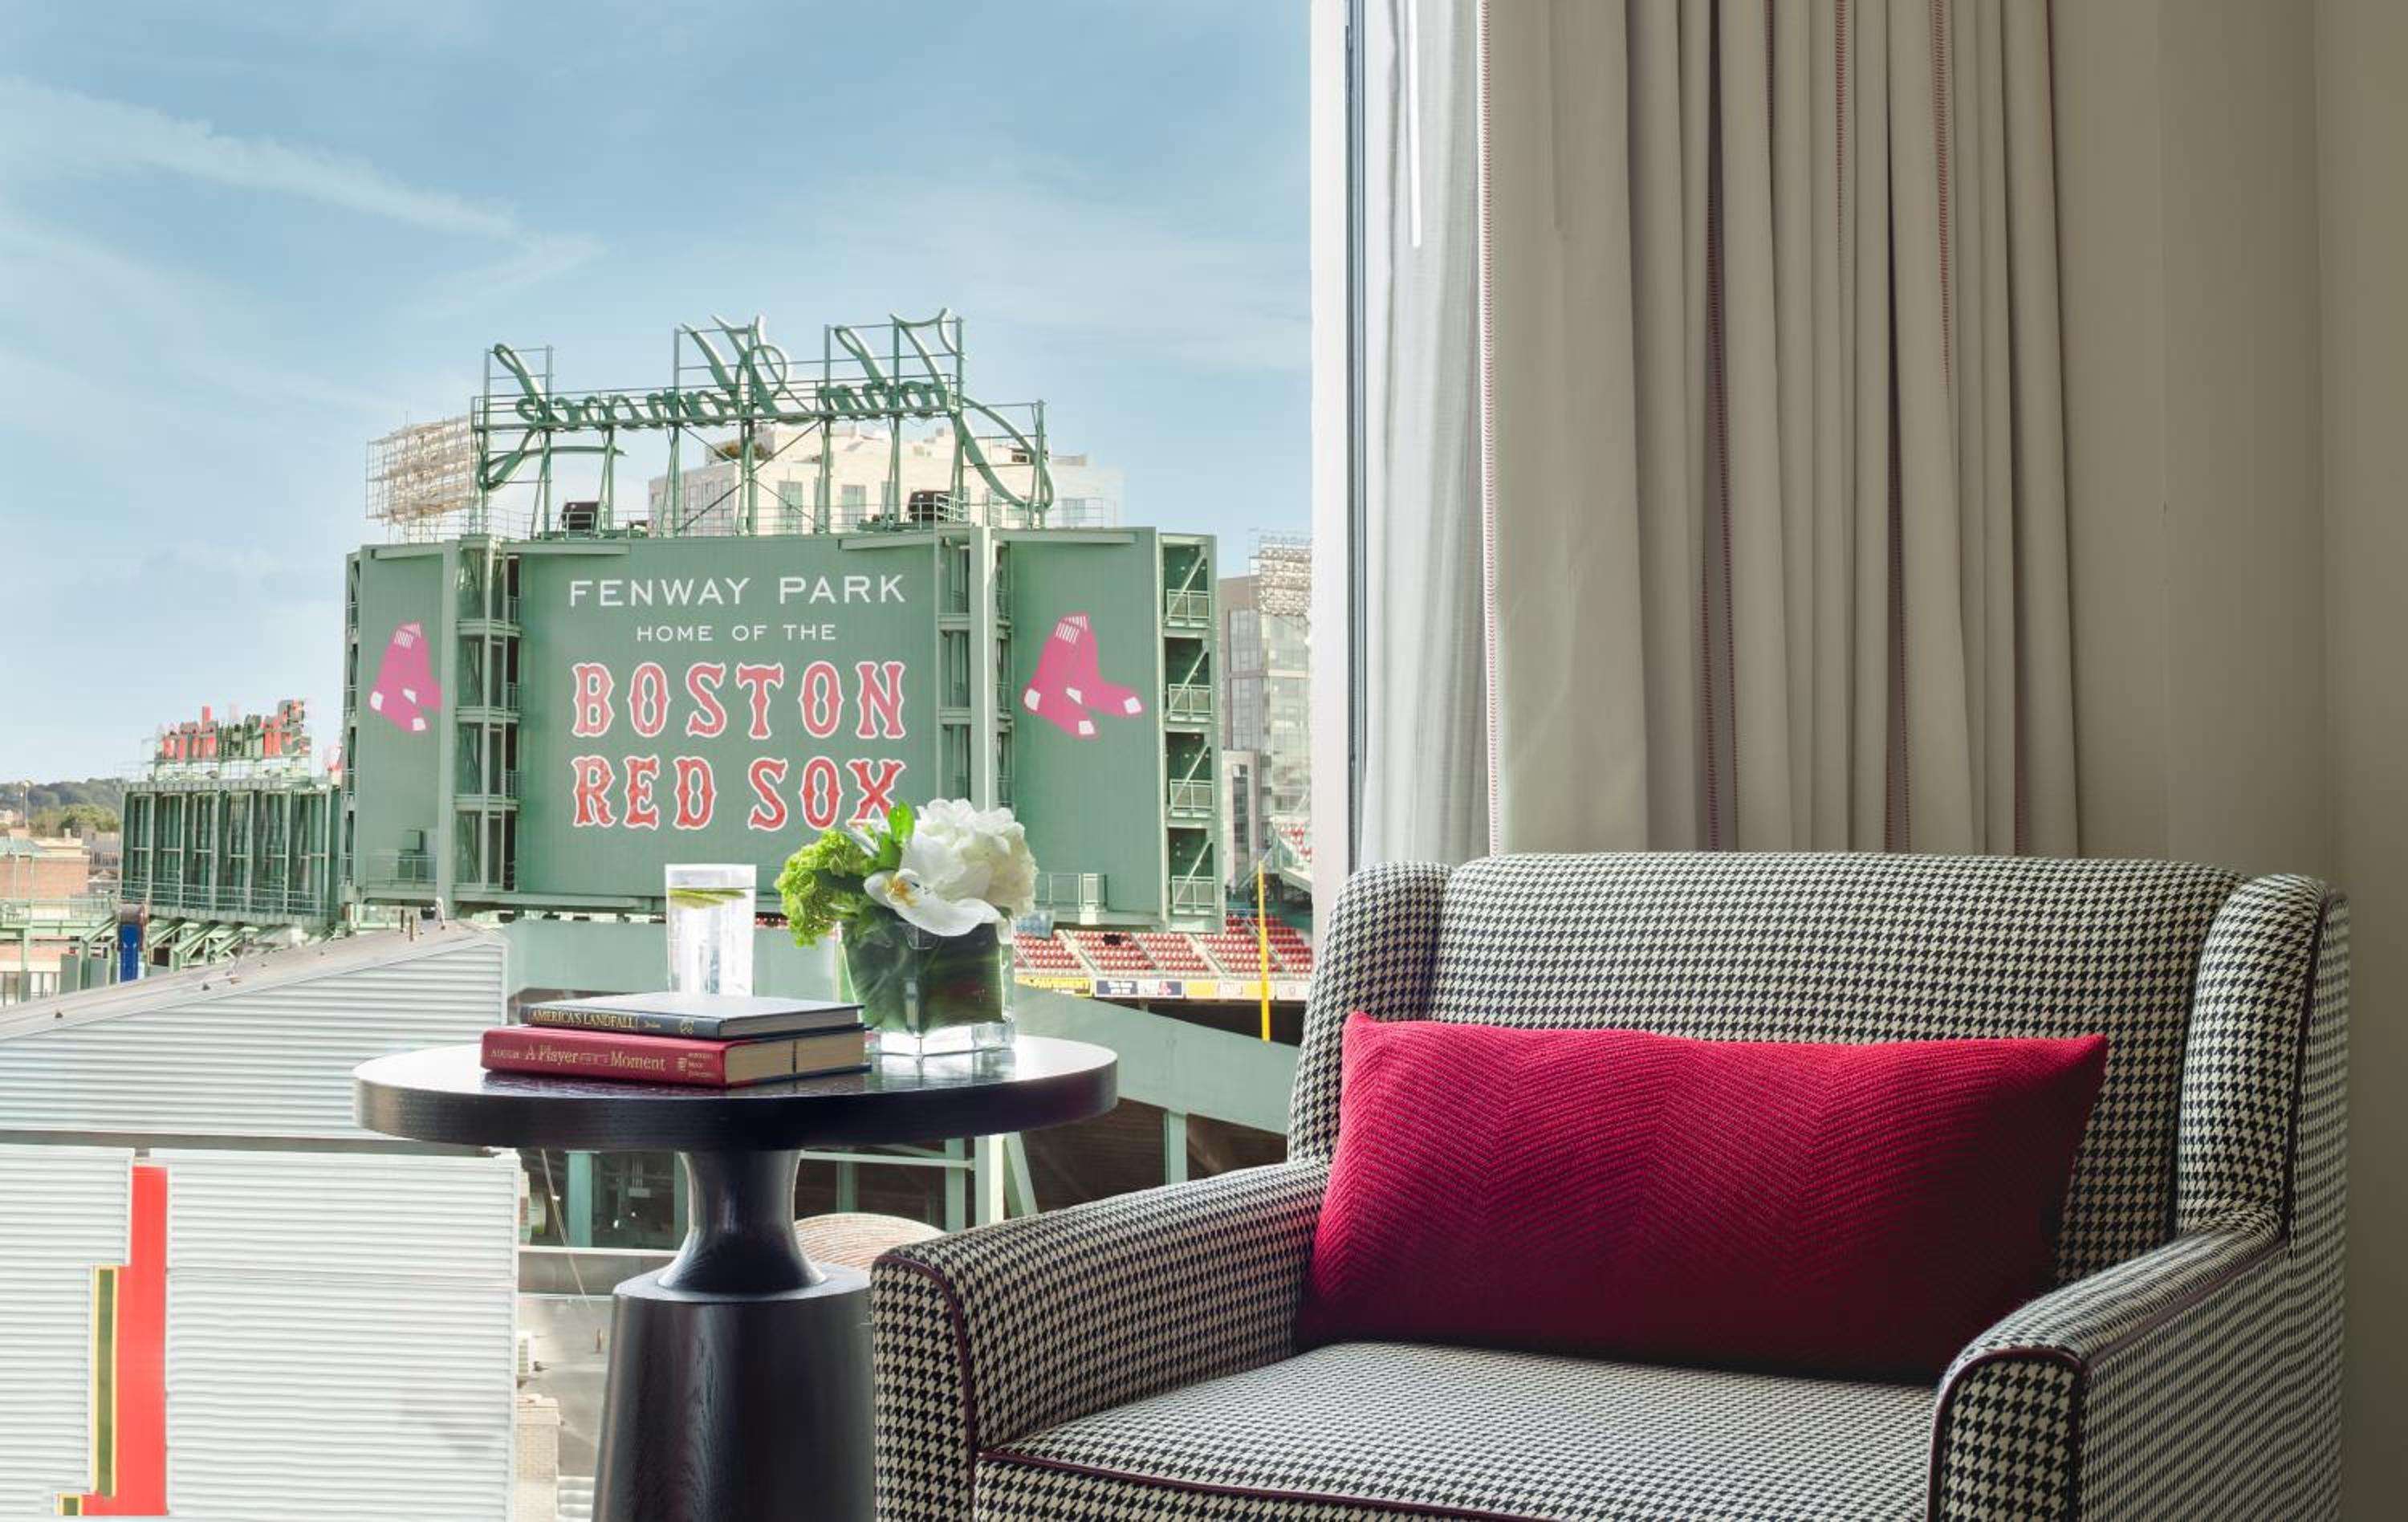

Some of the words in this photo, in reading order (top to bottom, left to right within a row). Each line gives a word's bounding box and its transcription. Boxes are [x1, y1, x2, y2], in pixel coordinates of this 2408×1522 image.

[569, 577, 750, 607] FENWAY
[779, 575, 906, 604] PARK
[636, 625, 713, 641] HOME
[731, 625, 768, 641] OF
[783, 624, 836, 641] THE
[571, 661, 907, 739] BOSTON
[571, 755, 717, 831] RED
[747, 756, 907, 832] SOX
[584, 1014, 633, 1029] LANDFALL
[525, 1045, 535, 1061] A
[539, 1044, 579, 1065] Player
[611, 1052, 666, 1071] Moment
